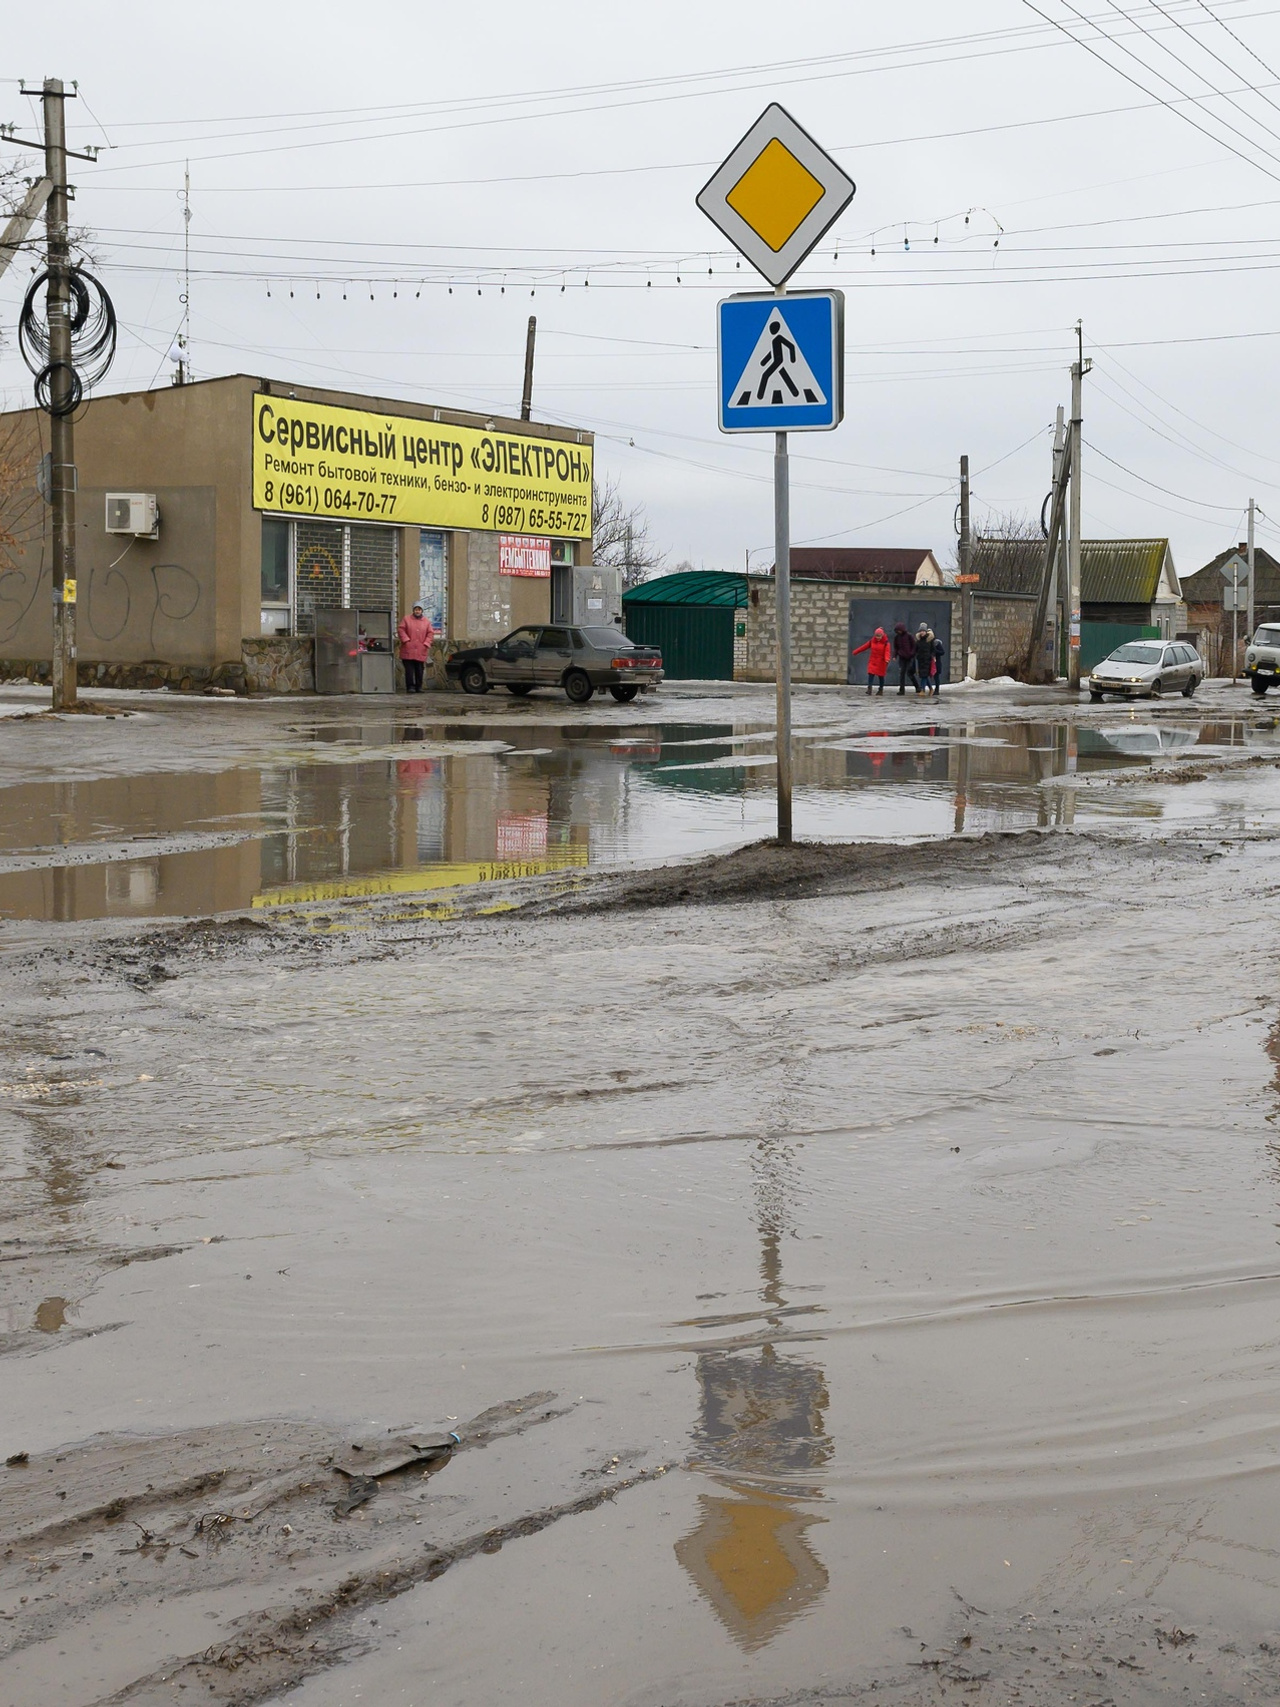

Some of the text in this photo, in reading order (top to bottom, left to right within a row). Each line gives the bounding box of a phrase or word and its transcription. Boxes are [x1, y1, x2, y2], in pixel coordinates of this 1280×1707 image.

[259, 404, 590, 483] Сервисный центр «ЭЛЕКТРОН»
[265, 453, 587, 507] Ремонт бытовой техники, бензо- и электроинструмента
[265, 481, 397, 514] 8 (961) 064-70-77
[482, 504, 587, 532] 8 (987) 65-55-727
